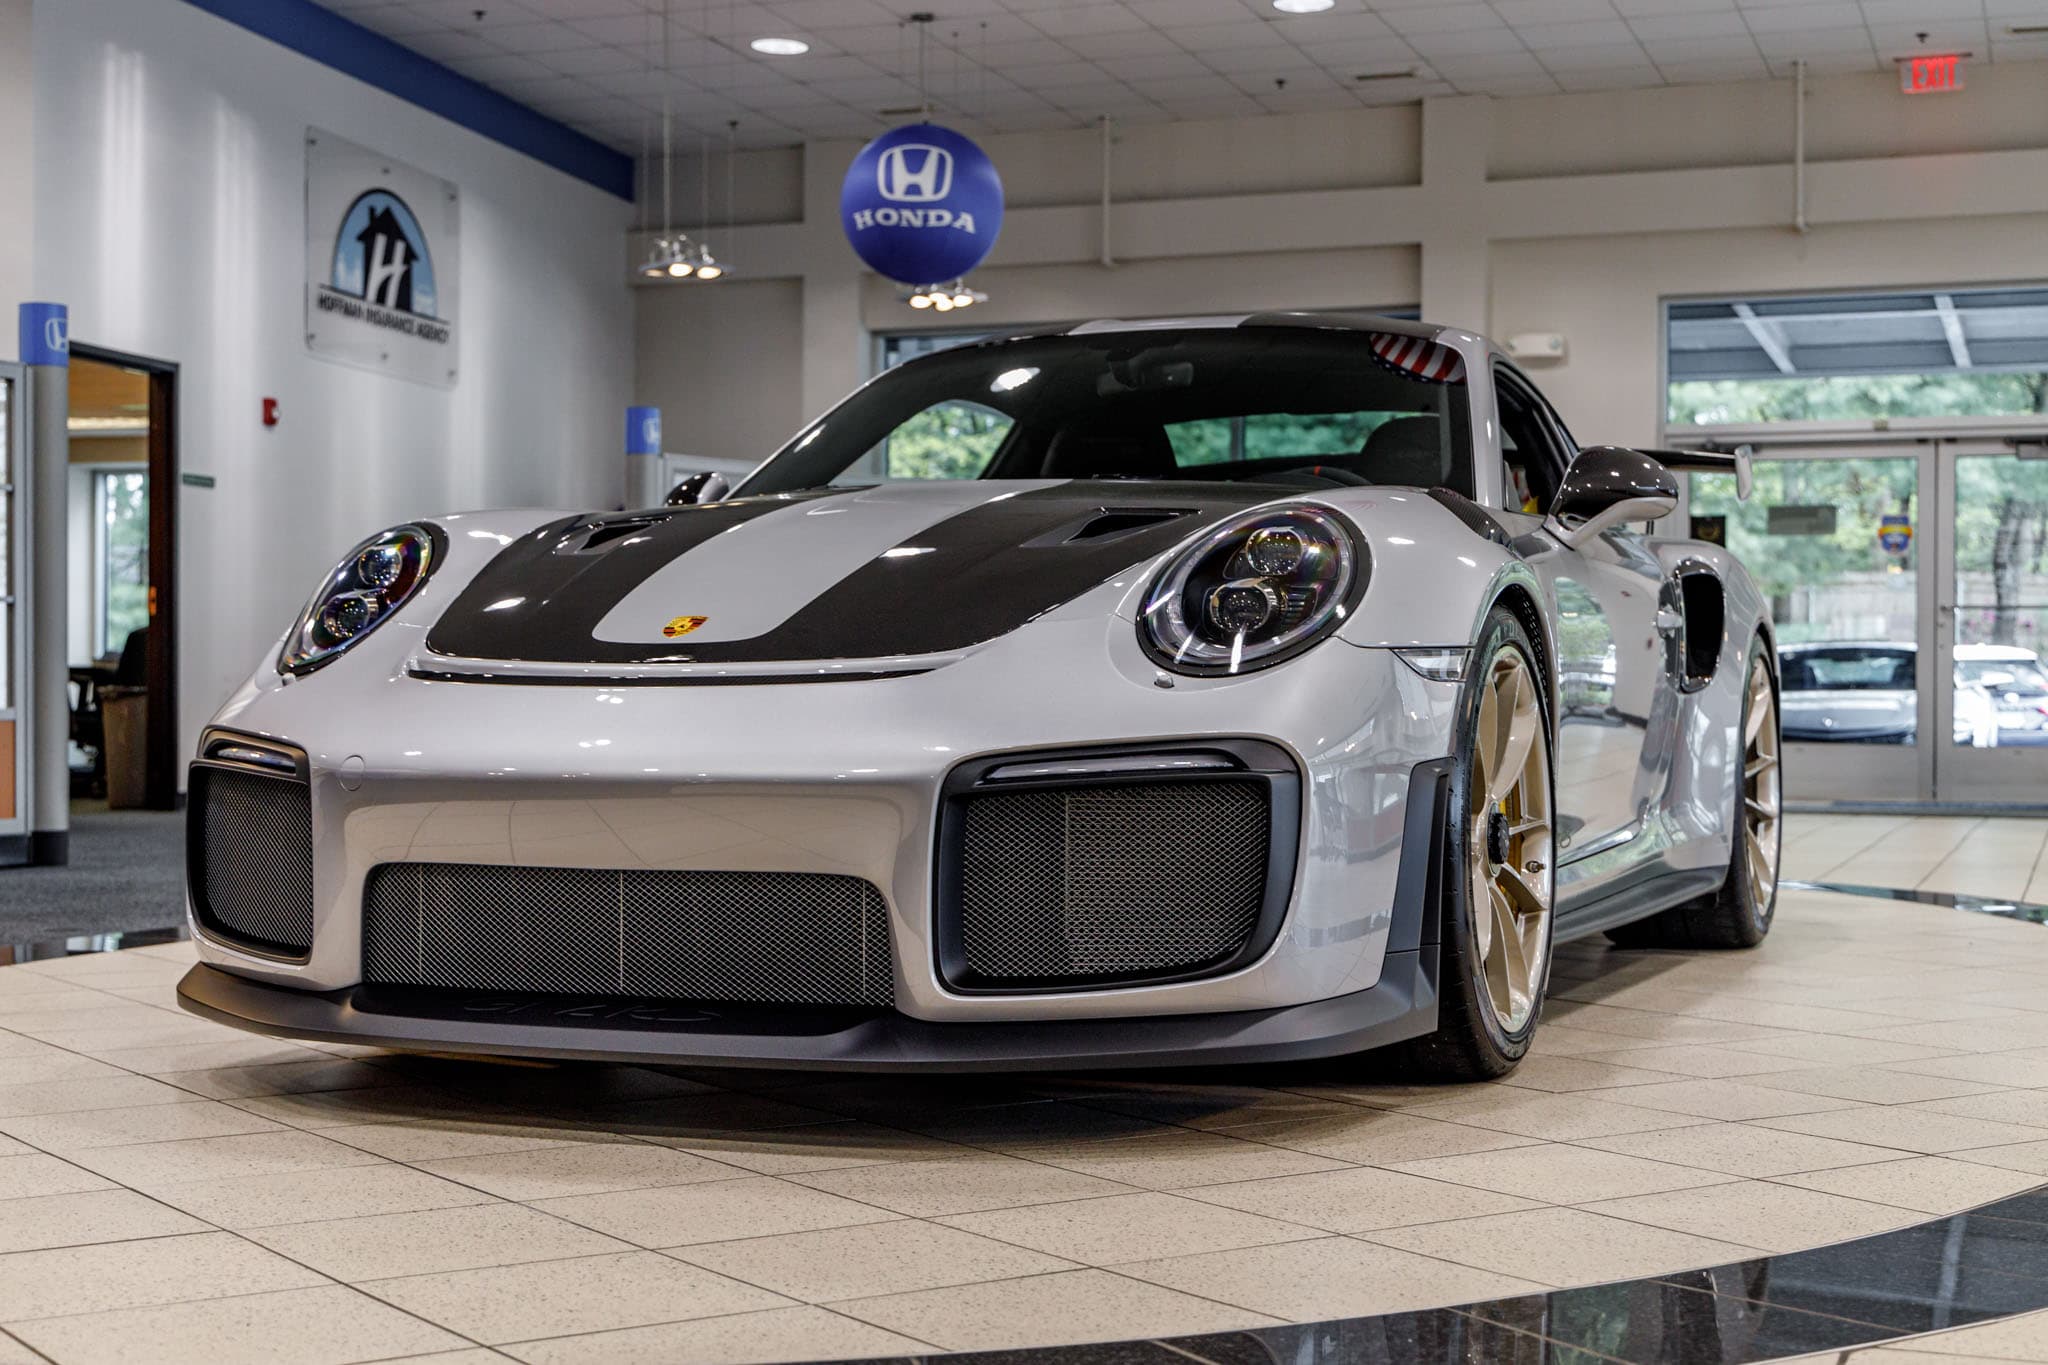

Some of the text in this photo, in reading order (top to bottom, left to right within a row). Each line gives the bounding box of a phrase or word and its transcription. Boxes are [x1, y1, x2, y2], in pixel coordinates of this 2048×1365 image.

[1912, 56, 1958, 90] EXIT
[853, 208, 976, 234] HONDA
[366, 307, 415, 336] INSURANCE
[416, 321, 449, 344] AGENCY
